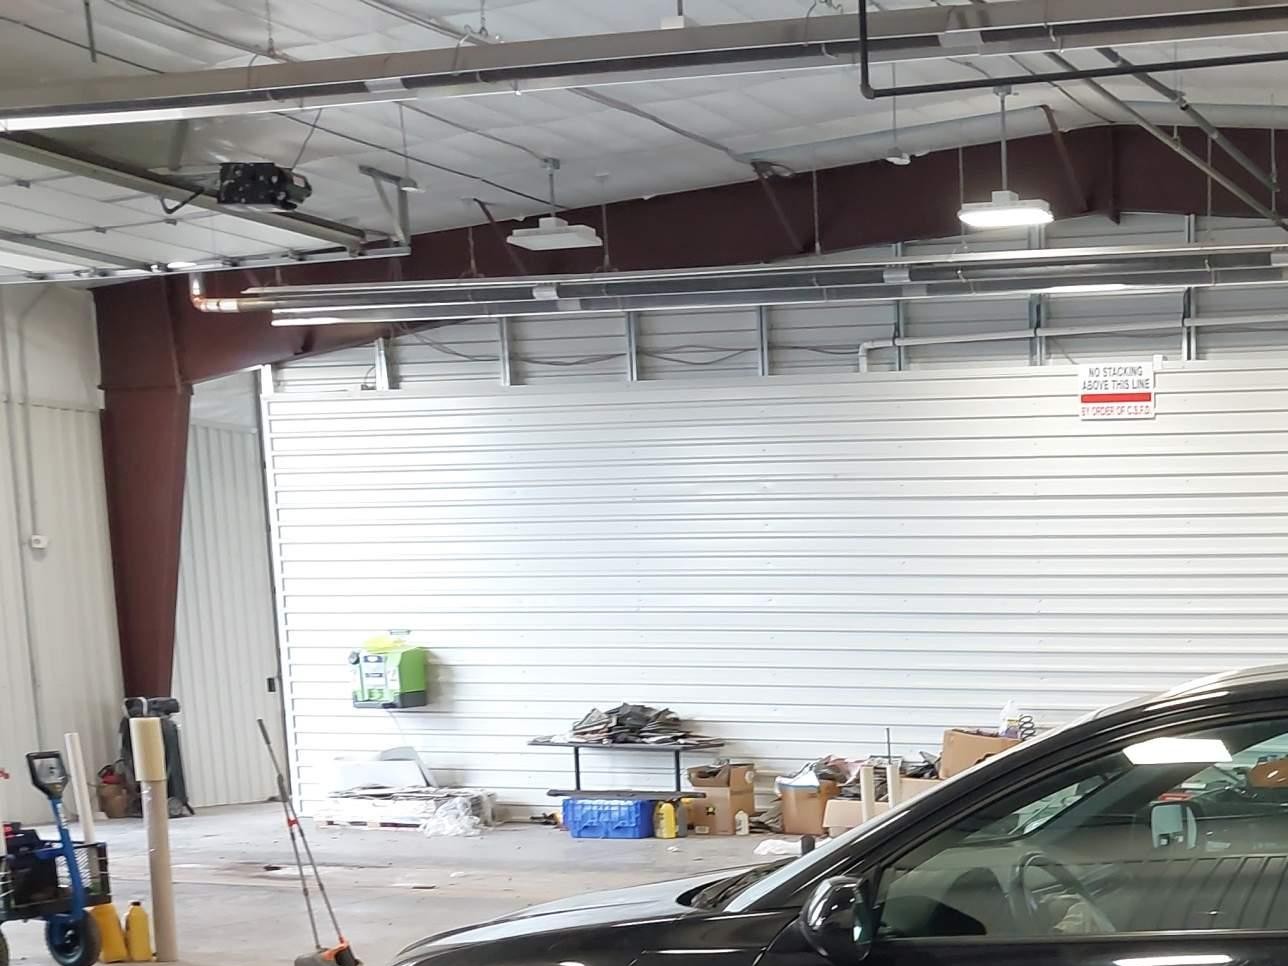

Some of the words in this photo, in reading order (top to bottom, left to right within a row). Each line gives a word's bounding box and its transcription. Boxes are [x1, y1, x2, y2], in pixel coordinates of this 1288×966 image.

[1088, 367, 1100, 377] NO
[1103, 366, 1142, 377] STACKING
[1082, 380, 1109, 390] ABOVE
[1112, 379, 1129, 390] THIS
[1132, 378, 1150, 389] LINE
